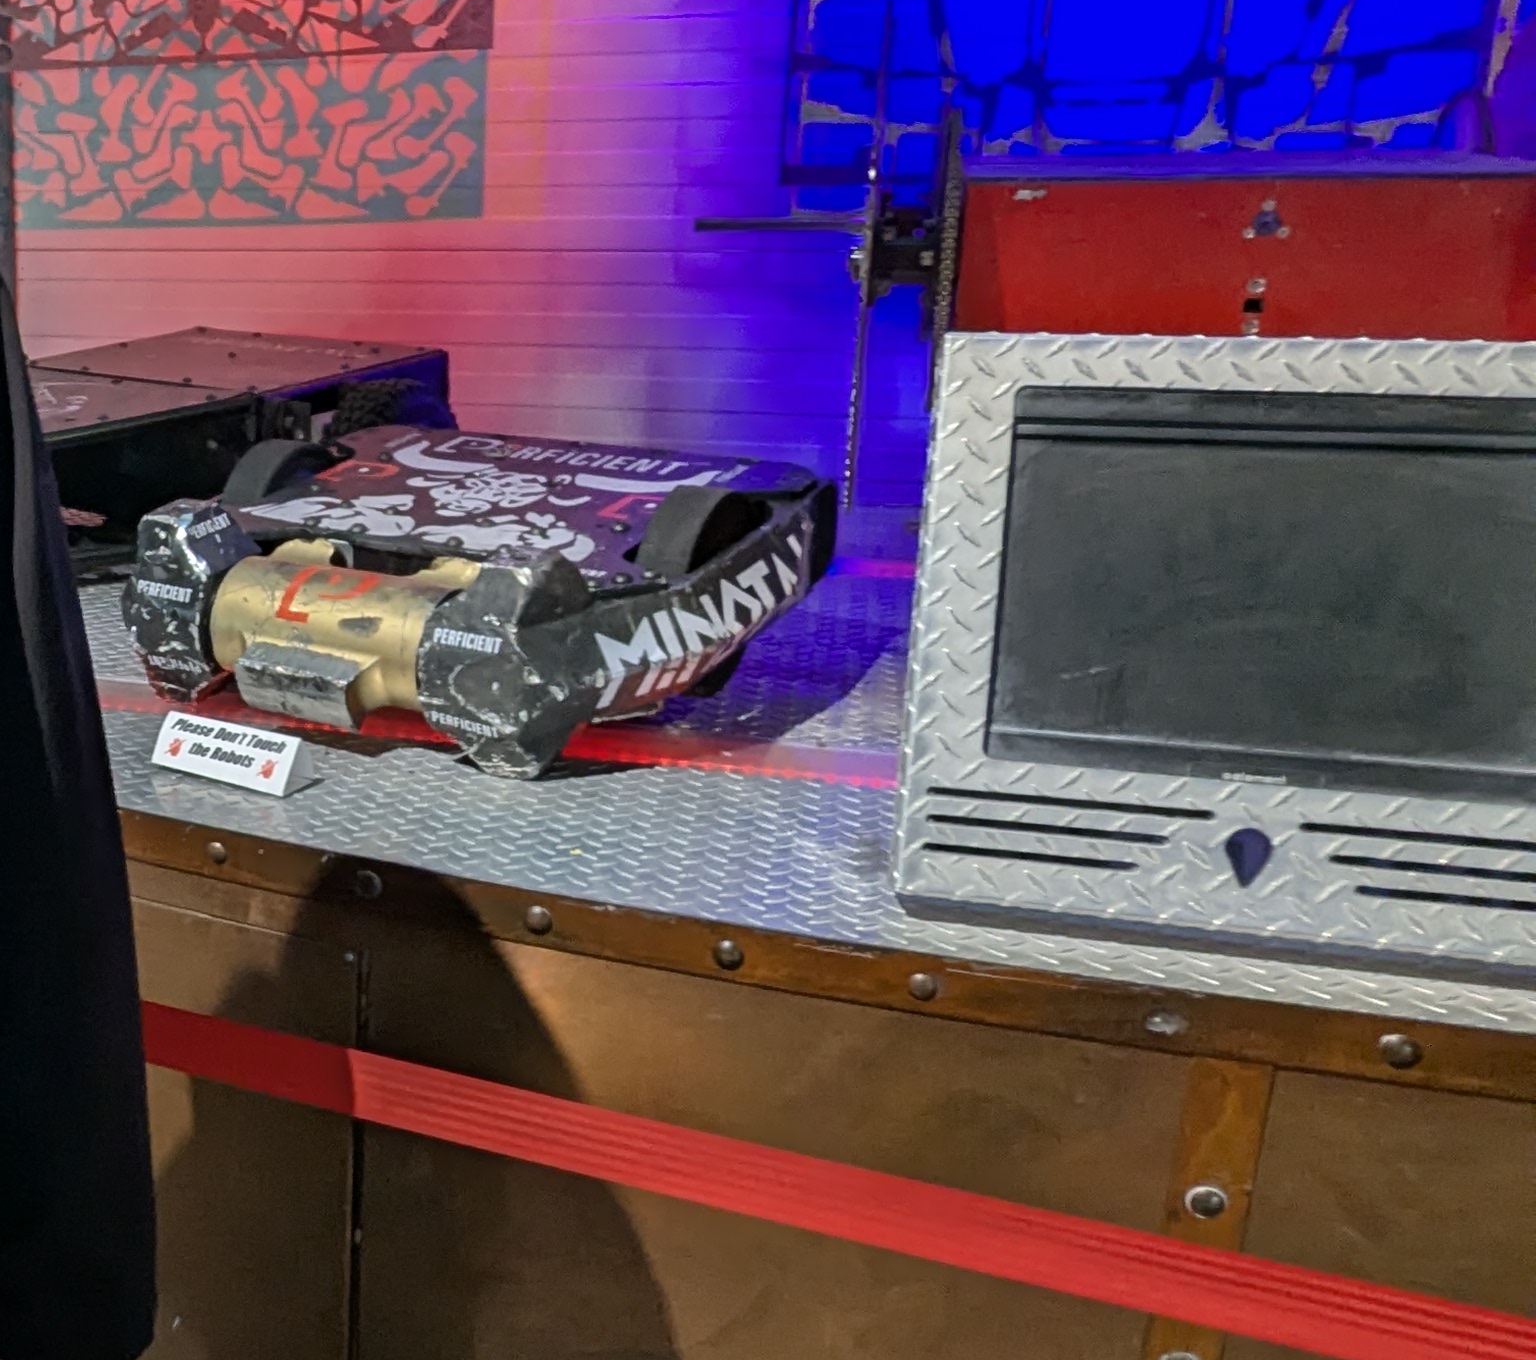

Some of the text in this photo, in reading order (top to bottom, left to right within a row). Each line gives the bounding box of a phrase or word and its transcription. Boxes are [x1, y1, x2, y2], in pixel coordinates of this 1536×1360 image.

[136, 578, 194, 604] PERFICIENT
[433, 627, 504, 655] PERFICIENT
[171, 718, 287, 754] Please Don't Touch
[188, 742, 255, 768] the Robots
